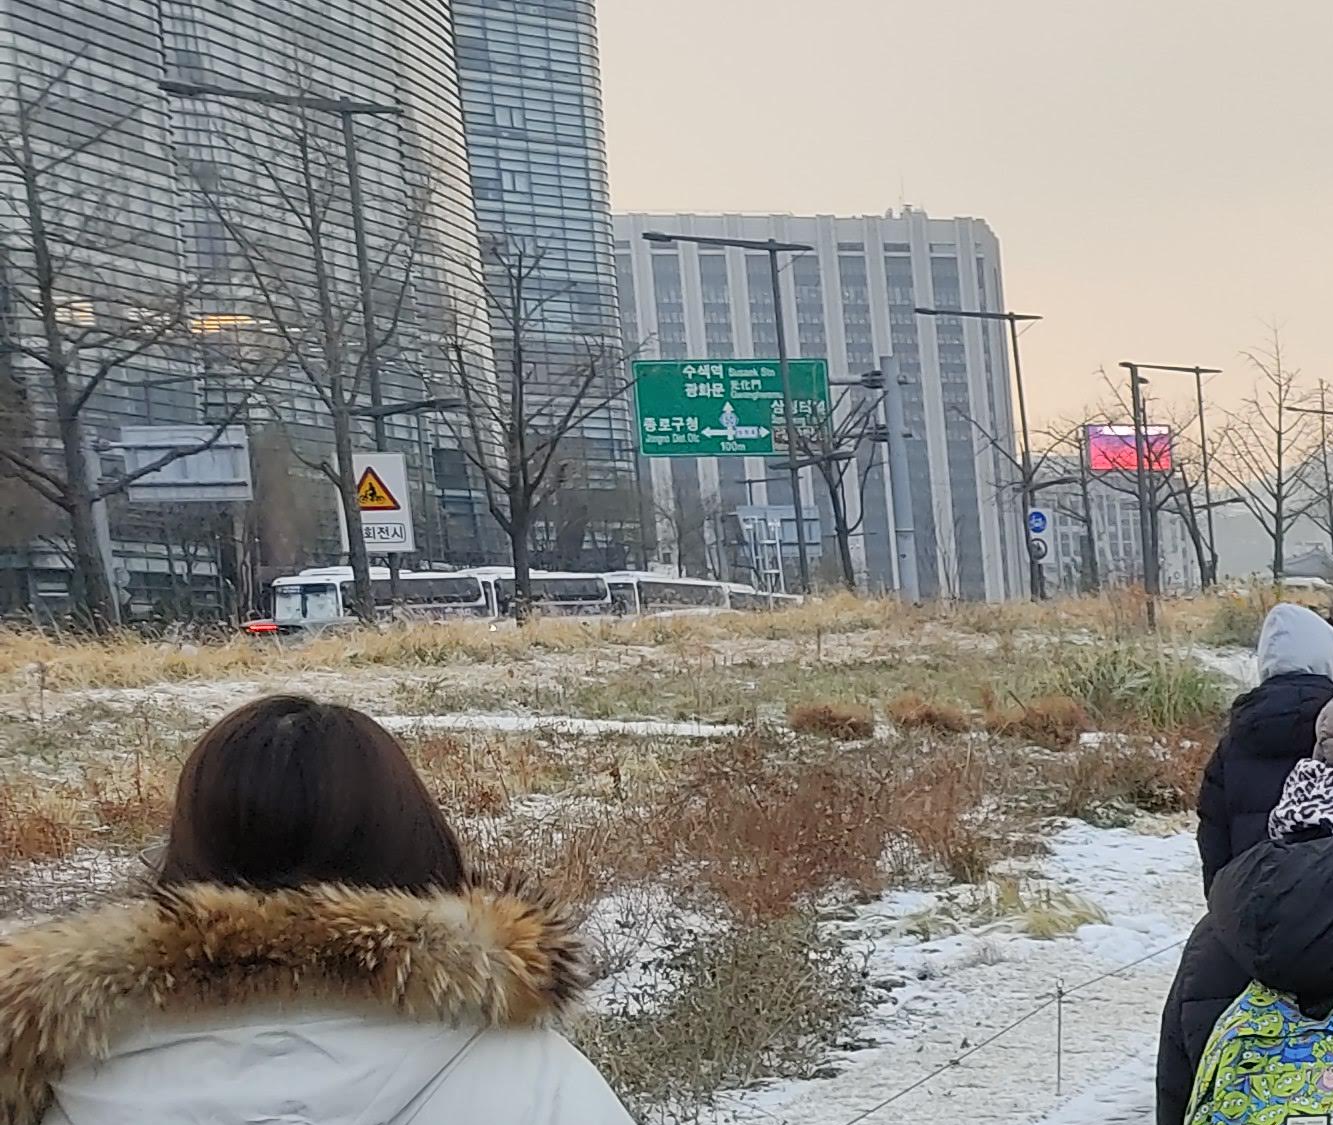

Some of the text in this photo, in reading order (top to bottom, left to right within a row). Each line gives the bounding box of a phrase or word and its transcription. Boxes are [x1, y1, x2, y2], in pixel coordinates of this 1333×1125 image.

[682, 363, 724, 379] 수색역
[683, 382, 725, 399] 광화문
[643, 416, 699, 432] 종로구청
[720, 441, 746, 452] 100m
[363, 526, 403, 540] 회전시
